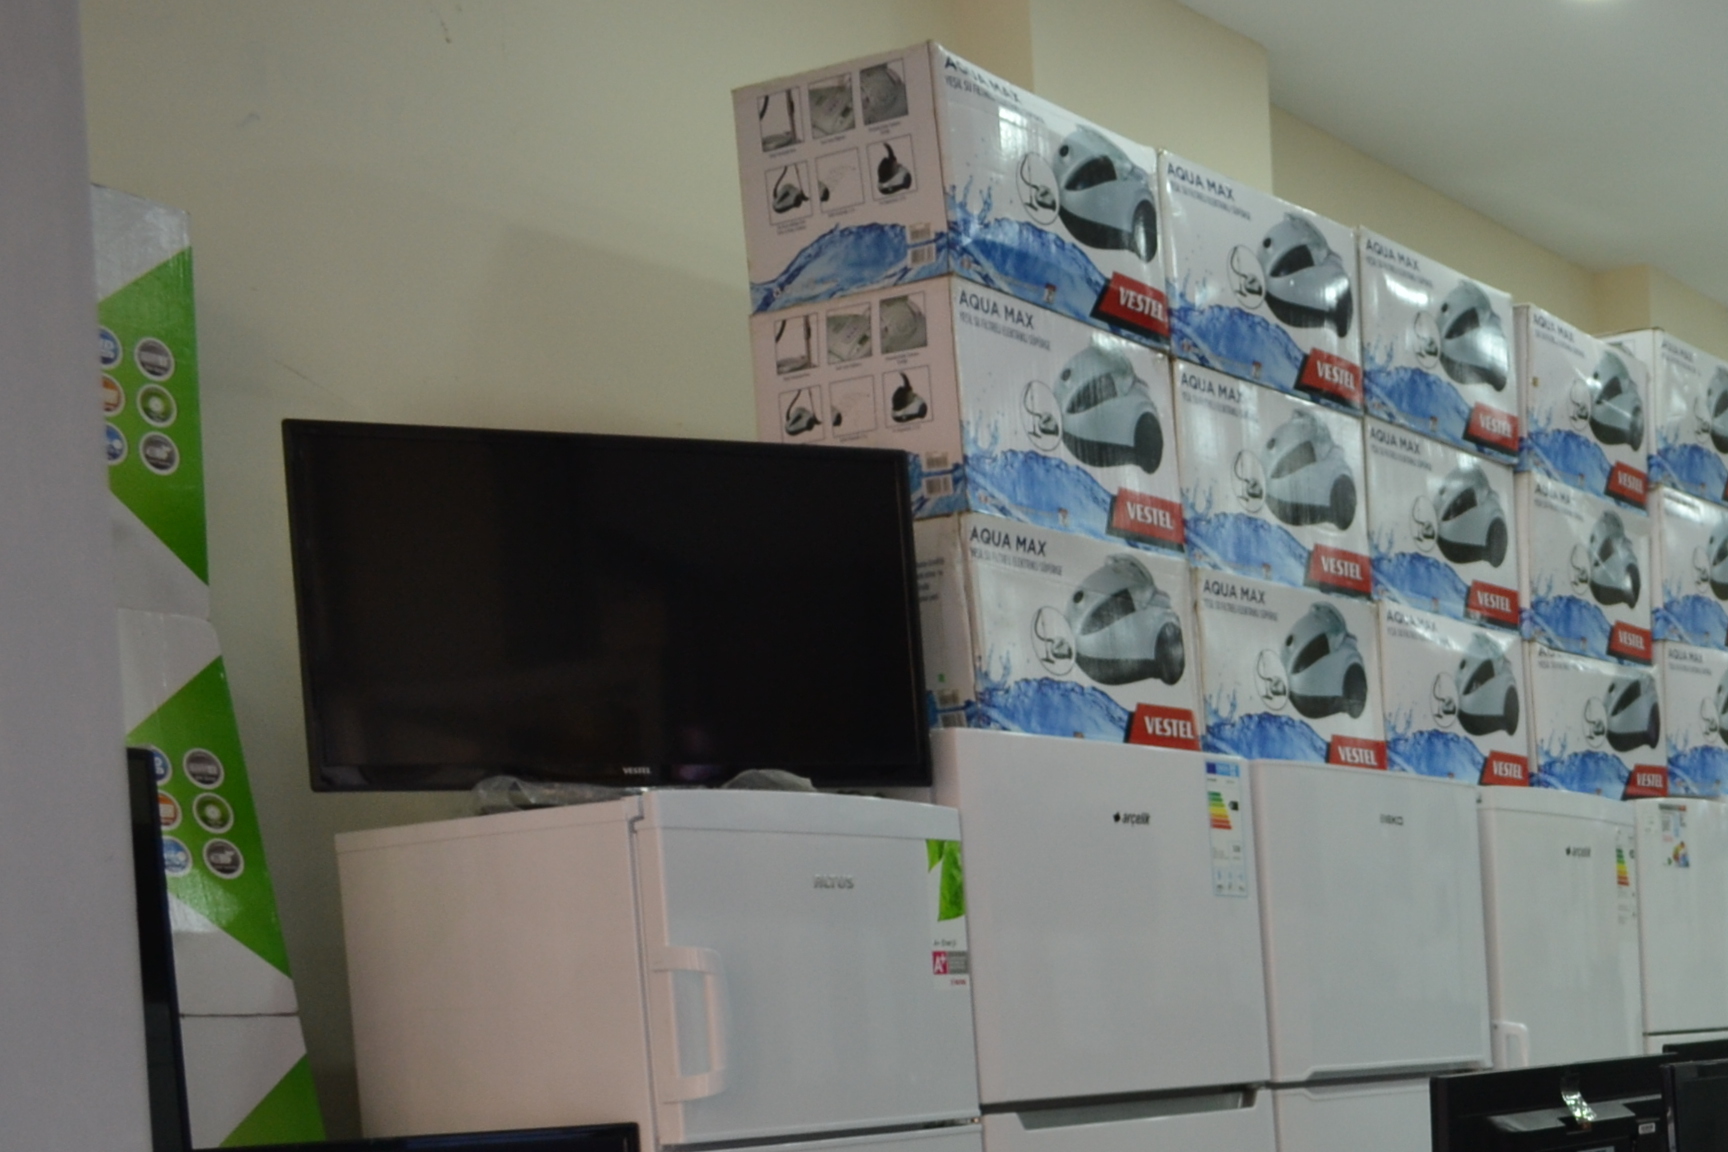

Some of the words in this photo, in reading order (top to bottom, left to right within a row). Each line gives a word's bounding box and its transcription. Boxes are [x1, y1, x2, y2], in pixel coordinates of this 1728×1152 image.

[1167, 162, 1203, 188] AQUA
[1206, 177, 1235, 201] MAX
[1366, 239, 1396, 261] AQUA
[1398, 253, 1420, 272] MAX
[959, 289, 1000, 317] AQUA
[1003, 304, 1035, 331] MAX
[1118, 286, 1166, 322] VESTEL
[1181, 372, 1214, 395] AQUA
[1217, 384, 1244, 404] MAX
[1316, 359, 1357, 391] VESTEL
[1478, 413, 1513, 438] VESTEL
[1370, 427, 1398, 447] AQUA
[1399, 437, 1421, 455] MAX
[1617, 471, 1644, 495] VESTEL
[1126, 500, 1175, 531] VESTEL
[970, 526, 1012, 550] AQUA
[1016, 536, 1047, 557] MAX
[1320, 556, 1365, 581] VESTEL
[1203, 579, 1237, 599] AQUA
[1240, 586, 1266, 605] MAX
[1477, 590, 1512, 613] VESTEL
[1618, 630, 1646, 651] VESTEL
[1143, 716, 1195, 740] VESTEL
[1336, 746, 1378, 767] VESTEL
[1492, 760, 1523, 780] VESTEL
[1636, 772, 1664, 788] VESTEL
